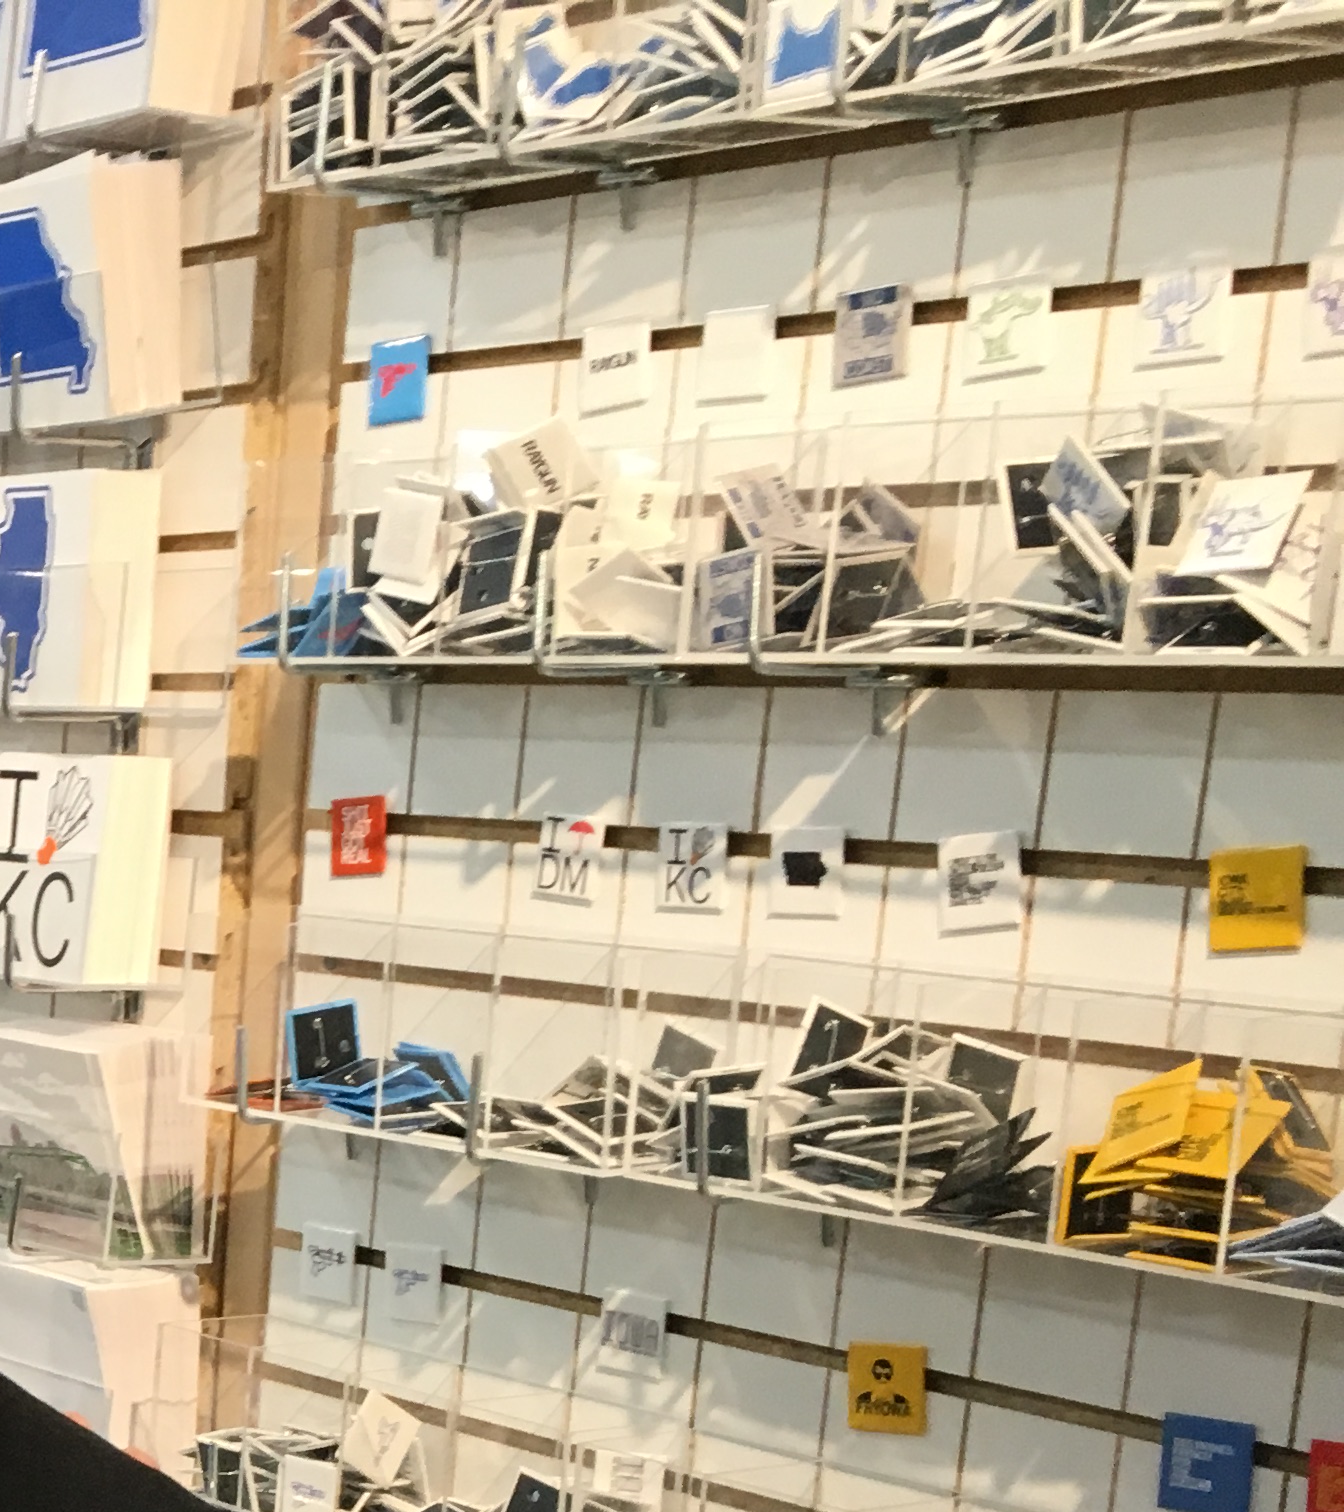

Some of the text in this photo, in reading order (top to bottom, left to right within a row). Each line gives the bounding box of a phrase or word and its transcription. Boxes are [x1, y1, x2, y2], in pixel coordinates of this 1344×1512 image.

[542, 816, 566, 853] I
[667, 828, 688, 865] I
[537, 853, 590, 895] DM
[665, 866, 712, 904] KC
